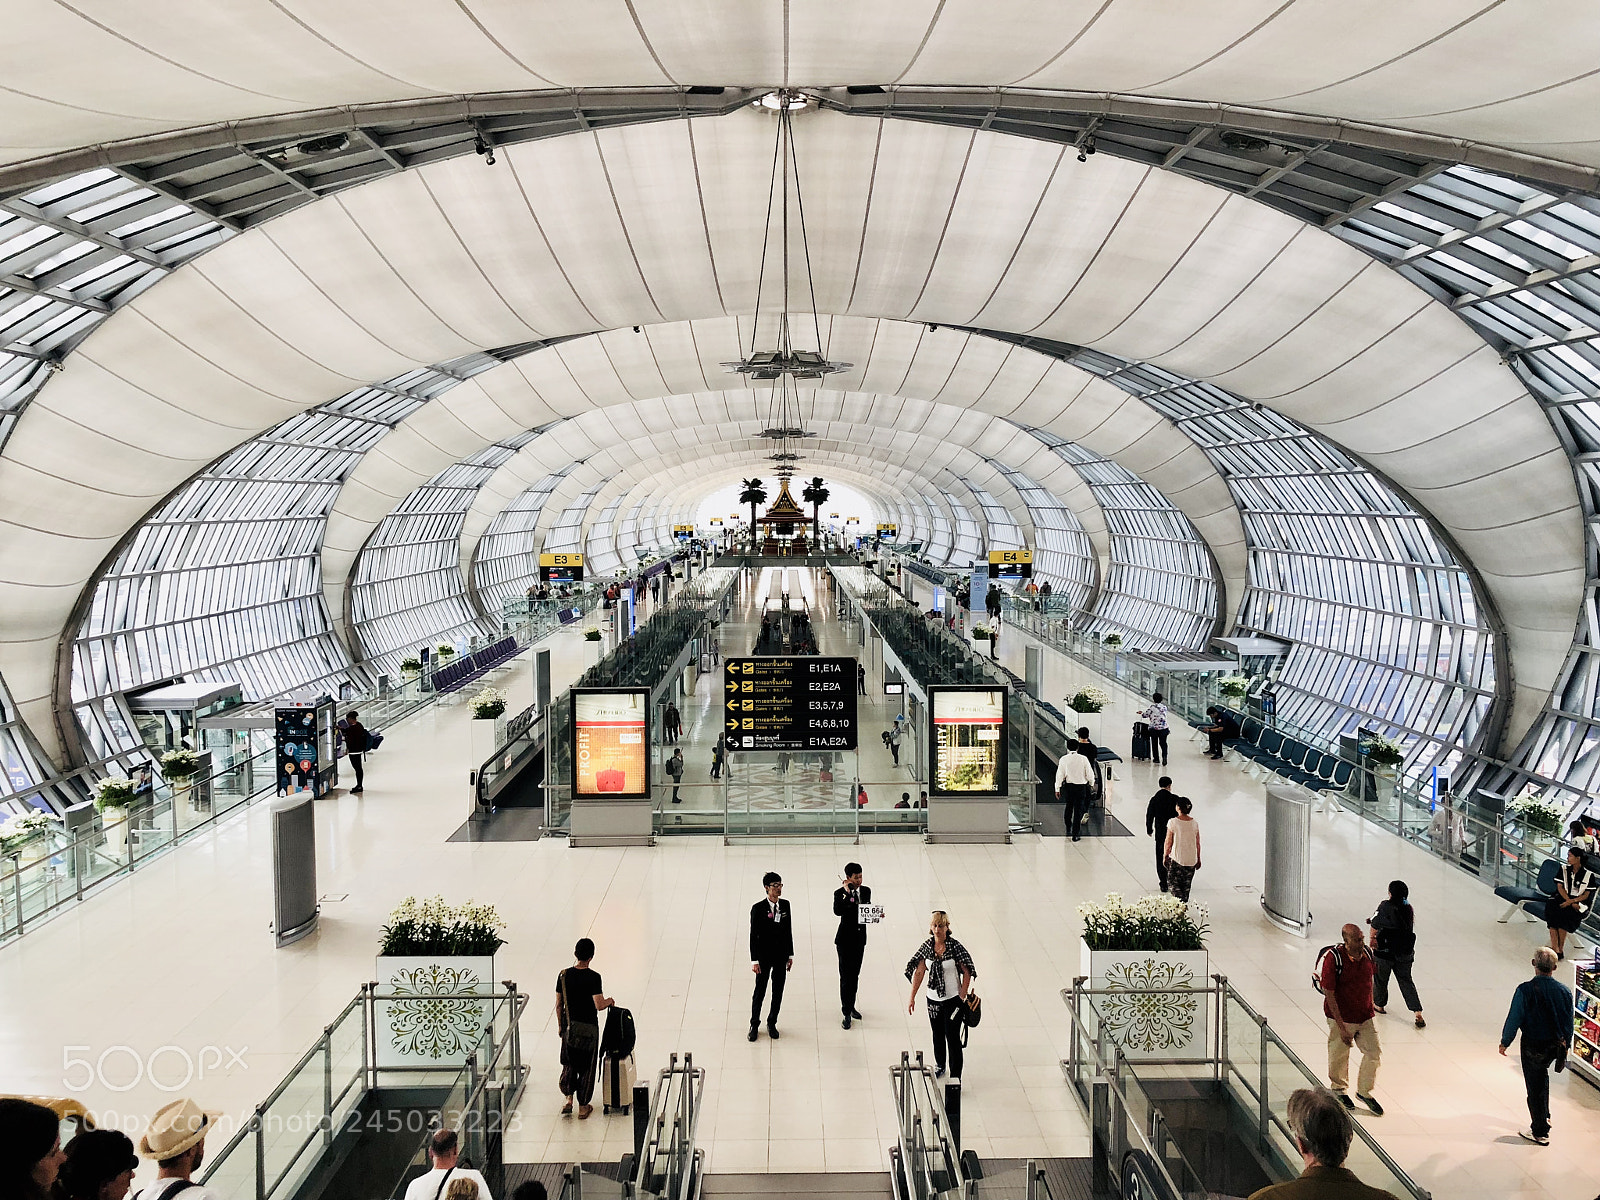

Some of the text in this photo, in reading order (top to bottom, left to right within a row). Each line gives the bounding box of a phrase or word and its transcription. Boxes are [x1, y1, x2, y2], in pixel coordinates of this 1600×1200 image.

[555, 556, 567, 564] E3
[1004, 553, 1017, 561] E4
[810, 664, 841, 672] E1,E1A
[809, 682, 840, 692] E2,E2A
[809, 701, 843, 710] E3,5,7,9
[809, 720, 849, 729] E4,6,8,10
[809, 738, 847, 746] E1A,E2A
[578, 732, 590, 776] PROFIT
